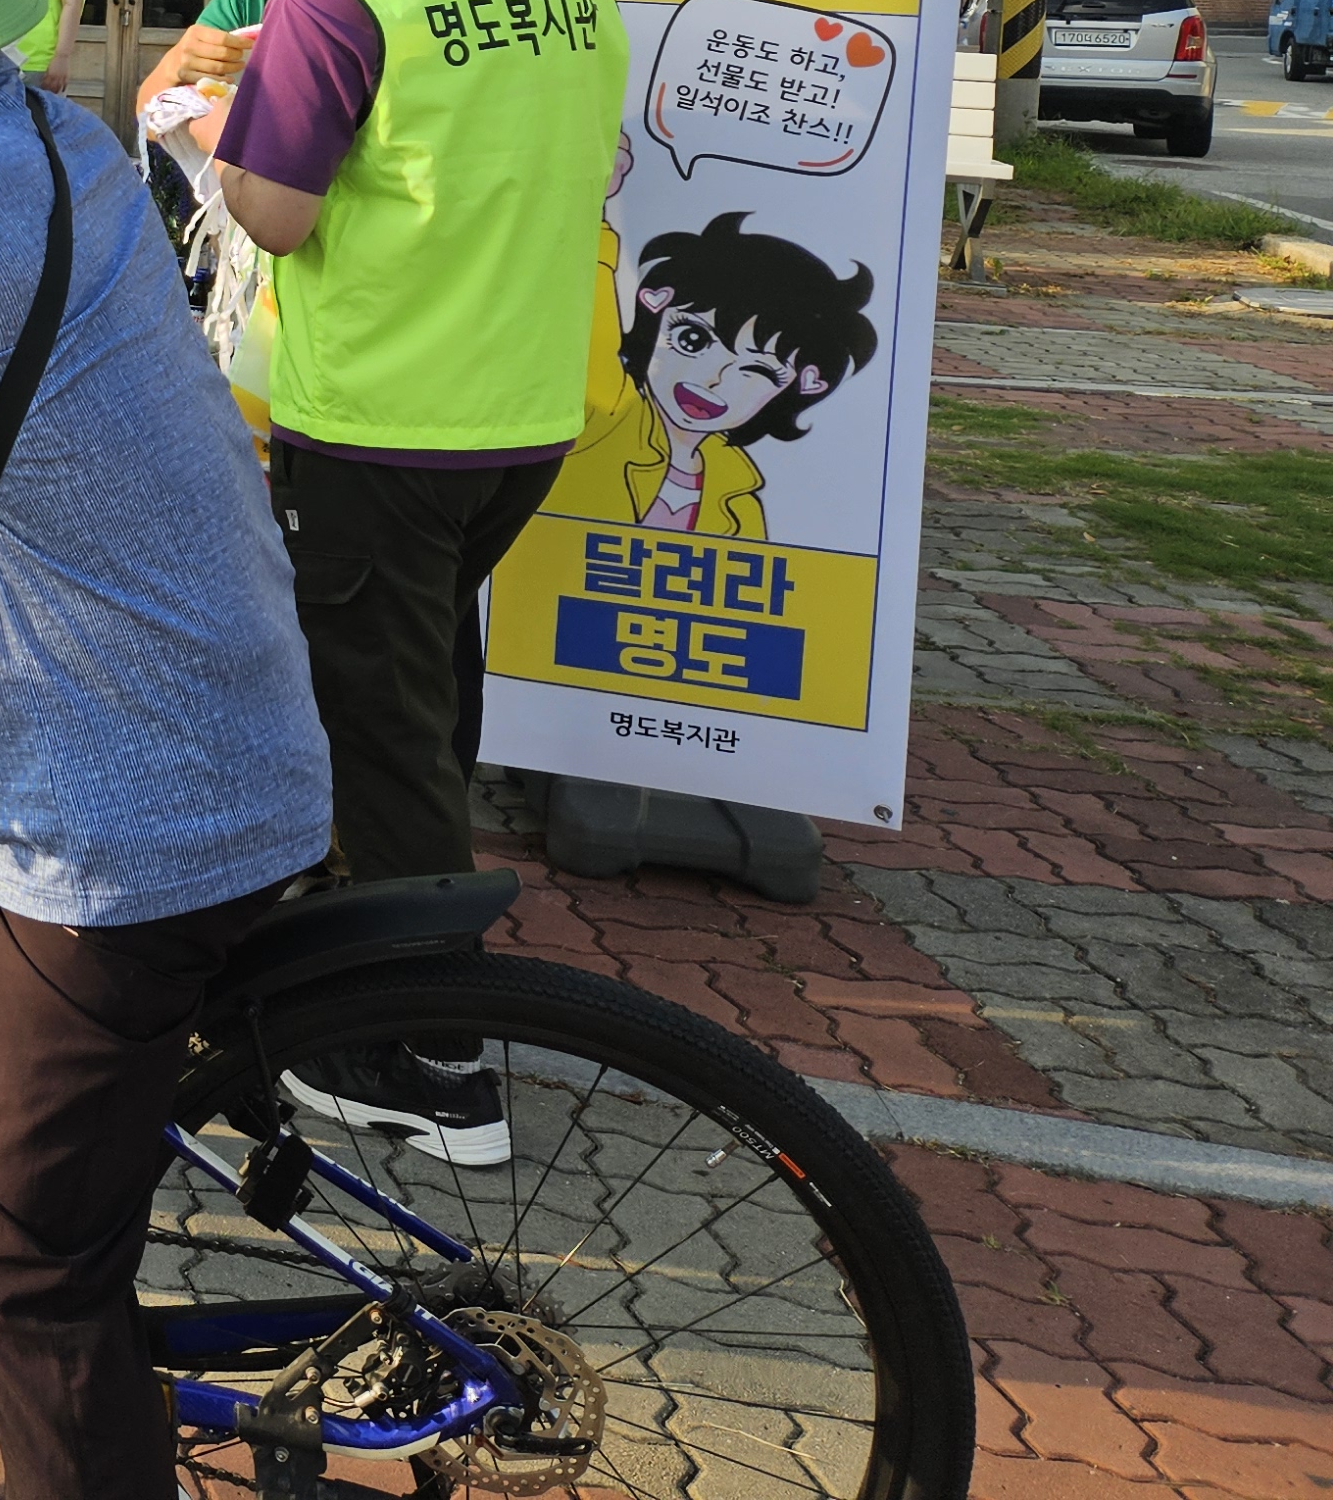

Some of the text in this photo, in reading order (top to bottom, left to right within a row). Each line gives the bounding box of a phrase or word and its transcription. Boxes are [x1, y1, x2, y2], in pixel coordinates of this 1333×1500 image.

[706, 29, 846, 82] 운동도 하고,
[1095, 33, 1126, 44] 6520
[697, 59, 841, 109] 선물도 받고!
[676, 85, 853, 145] 일석이조 찬스!!
[584, 532, 795, 617] 달려라
[615, 611, 749, 689] 명도
[609, 710, 741, 754] 명도복지관
[731, 1125, 775, 1160] MT500
